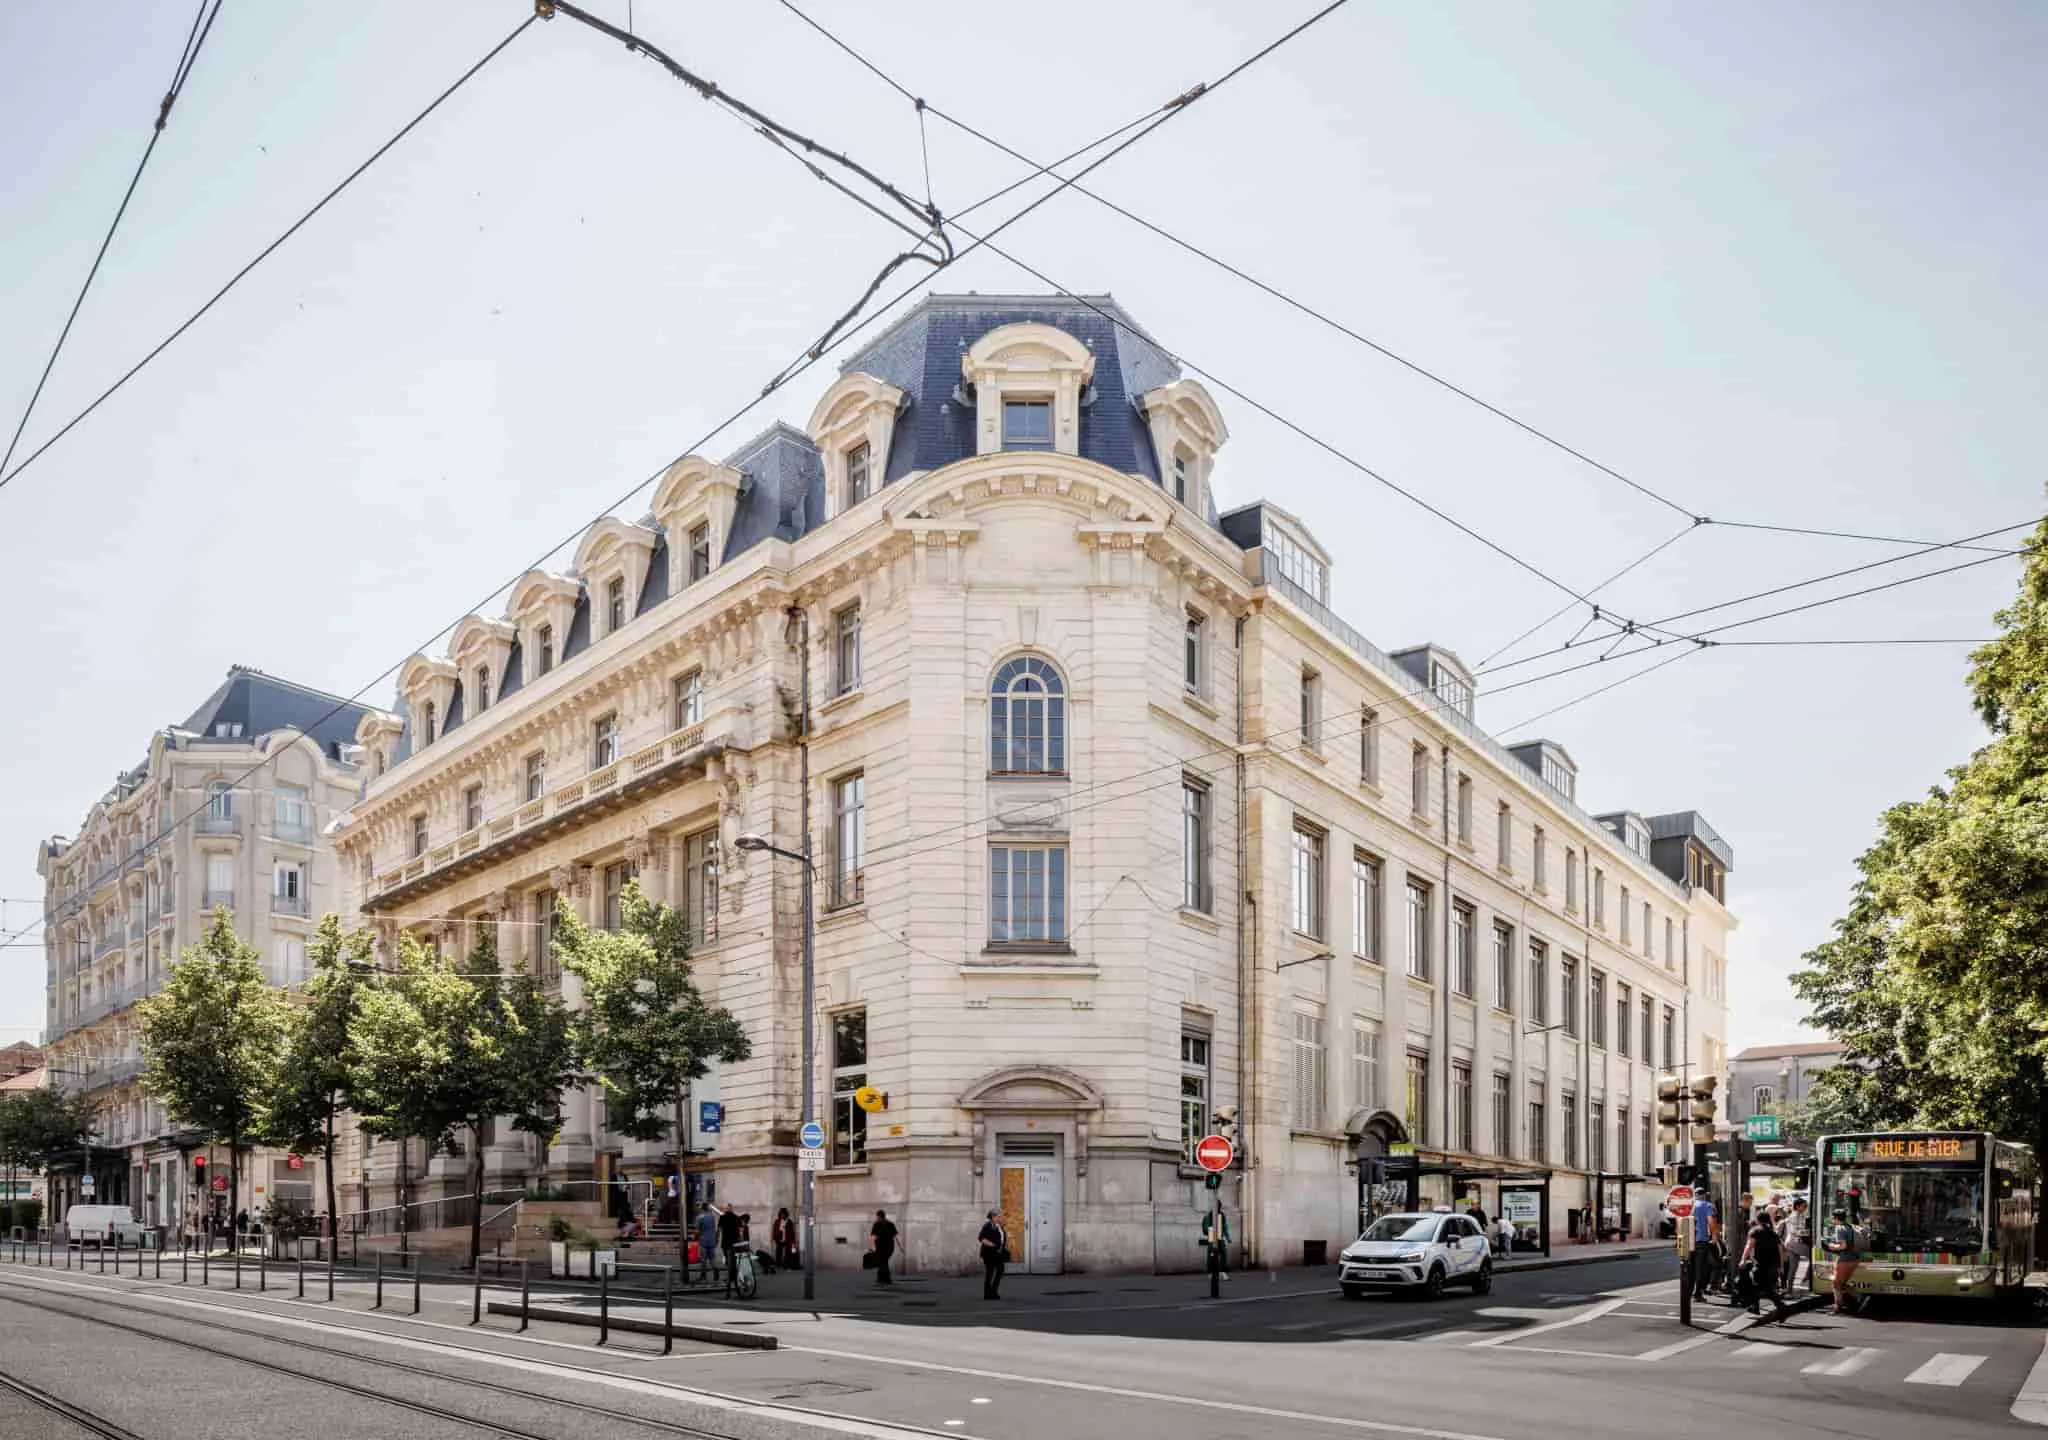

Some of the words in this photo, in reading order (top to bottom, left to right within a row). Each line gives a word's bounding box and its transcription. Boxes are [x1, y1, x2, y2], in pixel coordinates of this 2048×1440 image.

[1747, 1120, 1772, 1137] M5
[1874, 1140, 1904, 1157] RIVE
[1908, 1140, 1924, 1156] DE
[1928, 1139, 1960, 1156] GIER
